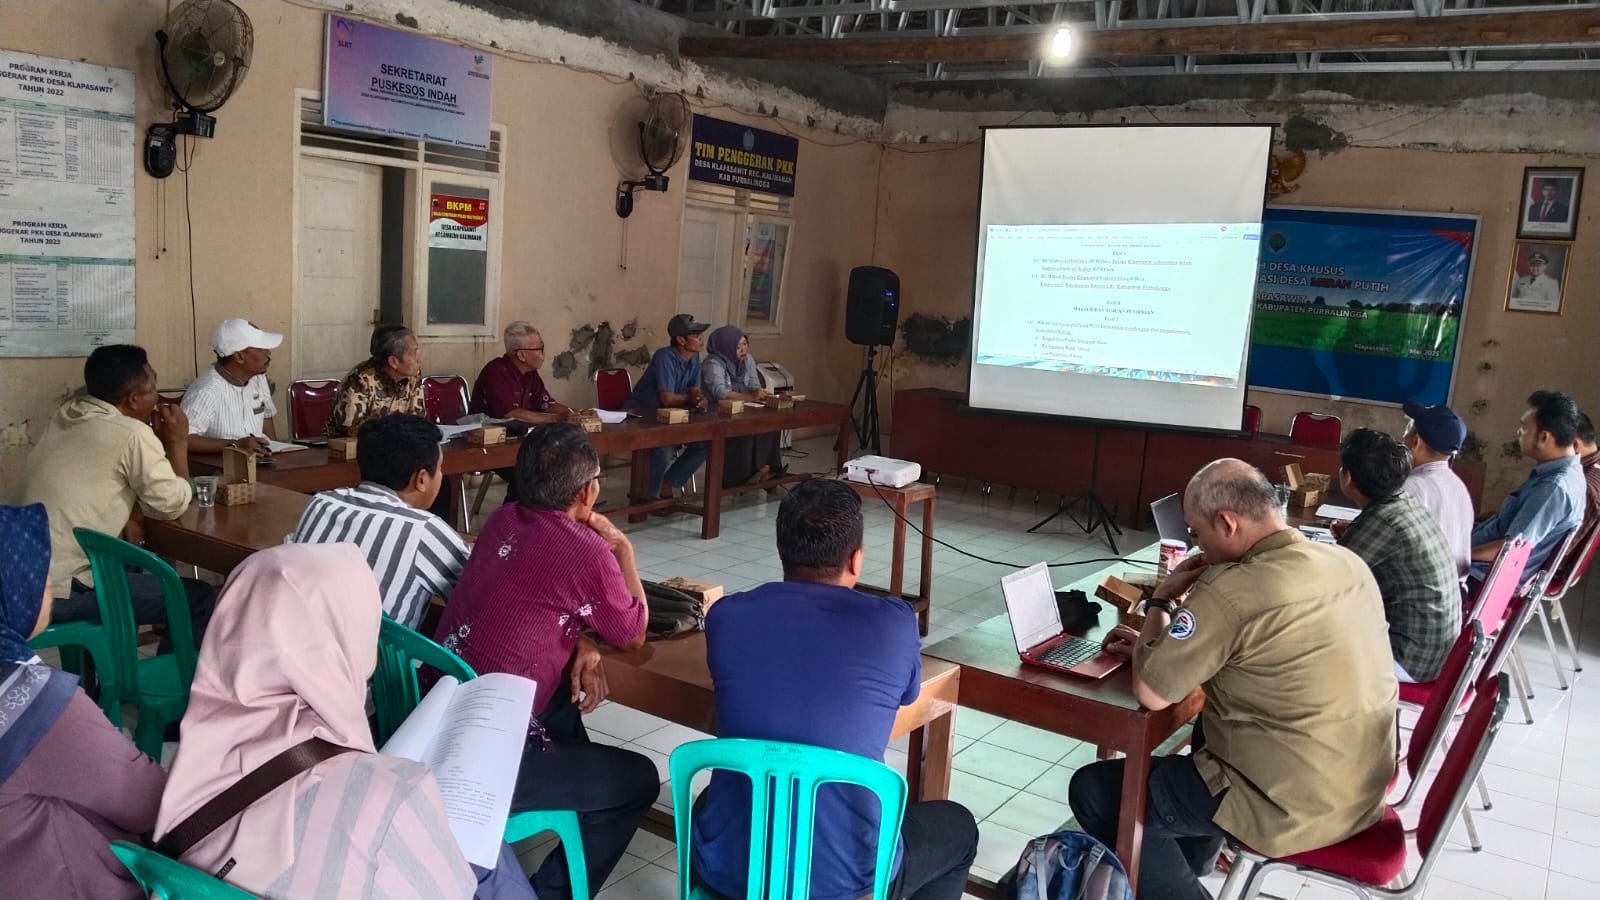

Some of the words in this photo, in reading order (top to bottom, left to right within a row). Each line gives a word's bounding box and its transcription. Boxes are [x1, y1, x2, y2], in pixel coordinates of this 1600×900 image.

[9, 62, 48, 75] PROGRAM
[49, 69, 72, 79] KERJA
[380, 63, 447, 87] SEKRETARIAT
[0, 71, 27, 81] GERAK
[29, 75, 45, 84] PKK
[46, 77, 65, 87] DESA
[67, 81, 113, 94] KLAPASAWIT
[18, 83, 45, 94] TAHUN
[46, 87, 64, 97] 2022
[371, 77, 425, 97] PUSKESOS
[427, 88, 457, 104] INDAH
[695, 141, 714, 159] TIM
[717, 146, 774, 170] PENGGERAK
[775, 158, 794, 175] PKK
[694, 158, 711, 169] DESA
[711, 163, 747, 176] KLAPASAWIT
[718, 173, 731, 182] KAB
[446, 200, 472, 212] BKPM
[12, 220, 47, 228] PROGRAM
[62, 231, 103, 239] KLAPASAWIT
[1269, 262, 1297, 273] DESA
[1300, 264, 1345, 276] KHUSUS
[1279, 275, 1307, 286] DESA
[1354, 281, 1390, 293] PUTIH
[1255, 291, 1307, 304] APASAWIT
[1257, 303, 1306, 313] KABUPATEN
[1307, 307, 1368, 319] PURBALINGGA
